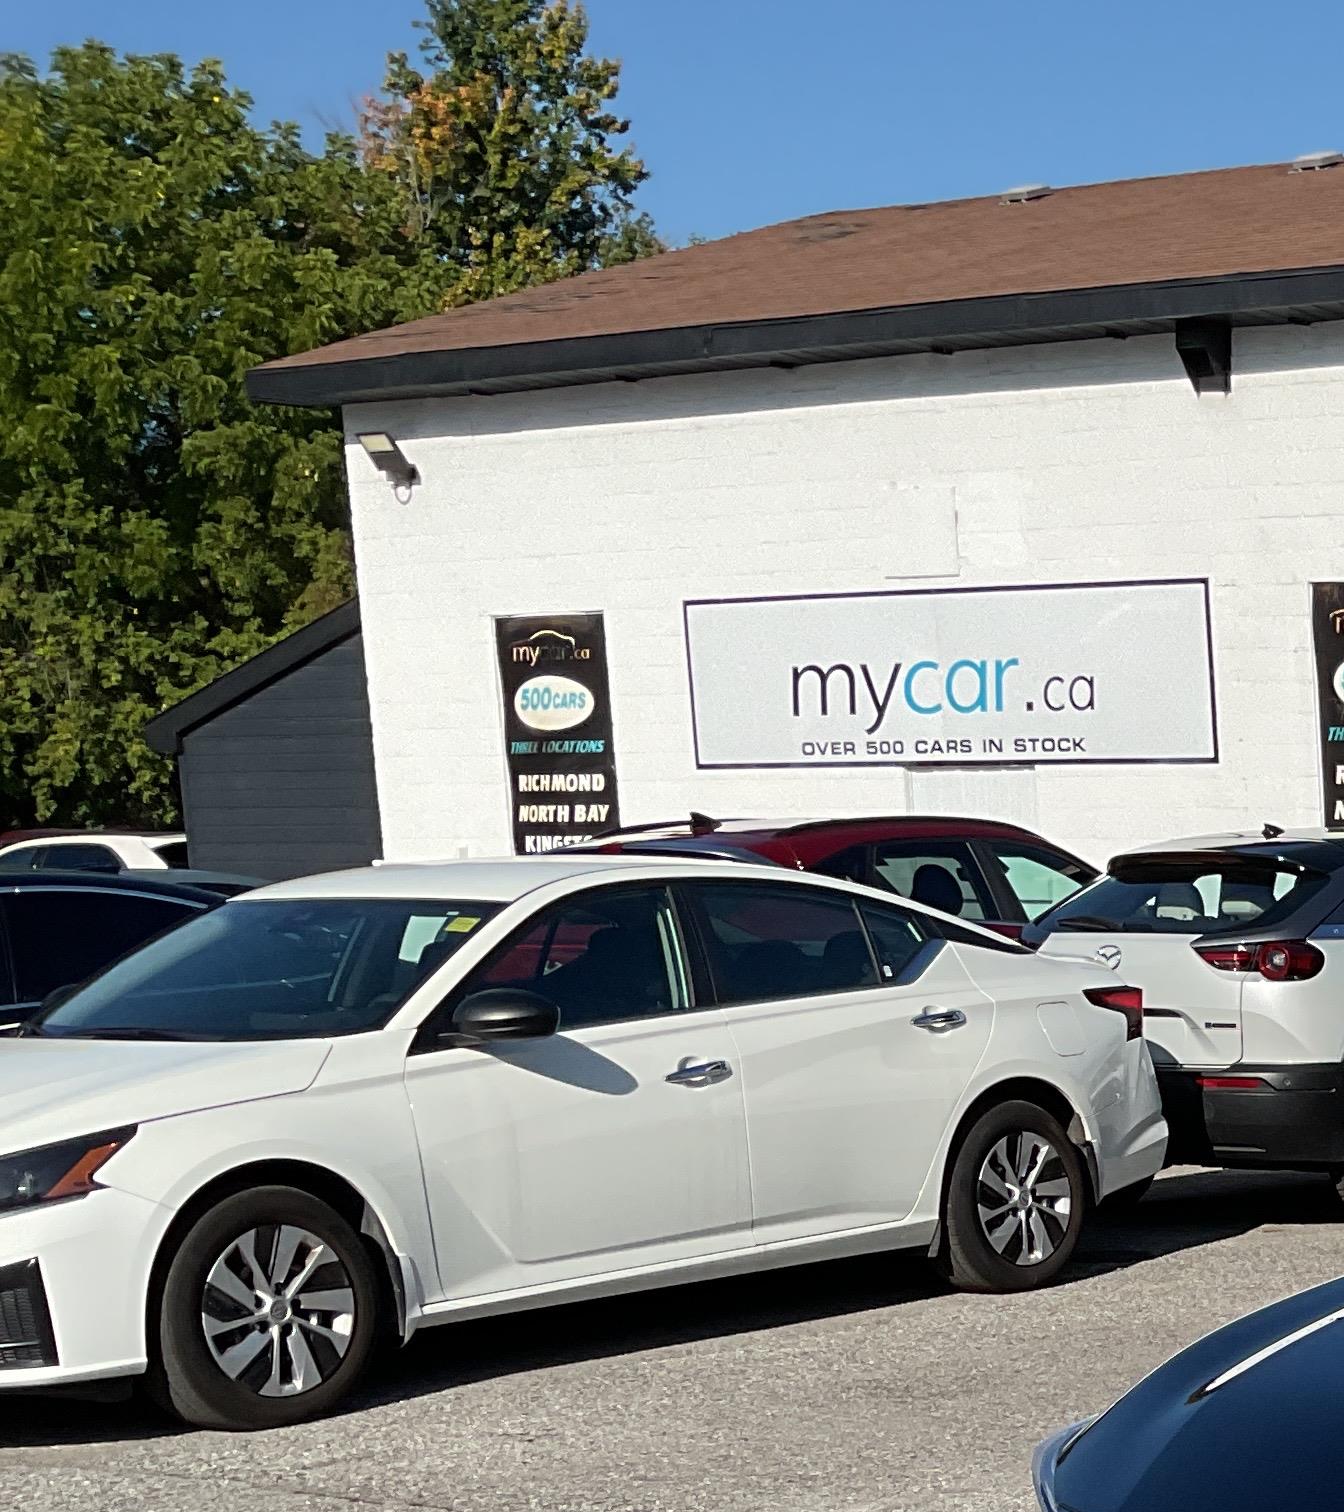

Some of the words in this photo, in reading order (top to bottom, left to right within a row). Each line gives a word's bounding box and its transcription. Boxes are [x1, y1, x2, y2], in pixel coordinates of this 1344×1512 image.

[792, 657, 1095, 735] mycar.ca
[511, 741, 539, 754] THREE
[542, 740, 605, 754] LOCATIONS
[802, 741, 857, 755] OVER
[866, 740, 904, 755] 500
[915, 739, 972, 755] CARS
[982, 738, 1003, 753] IN
[1014, 737, 1087, 752] STOCK
[518, 774, 605, 792] RICHMOND
[518, 804, 570, 823] NORTH
[574, 804, 610, 823] BAY
